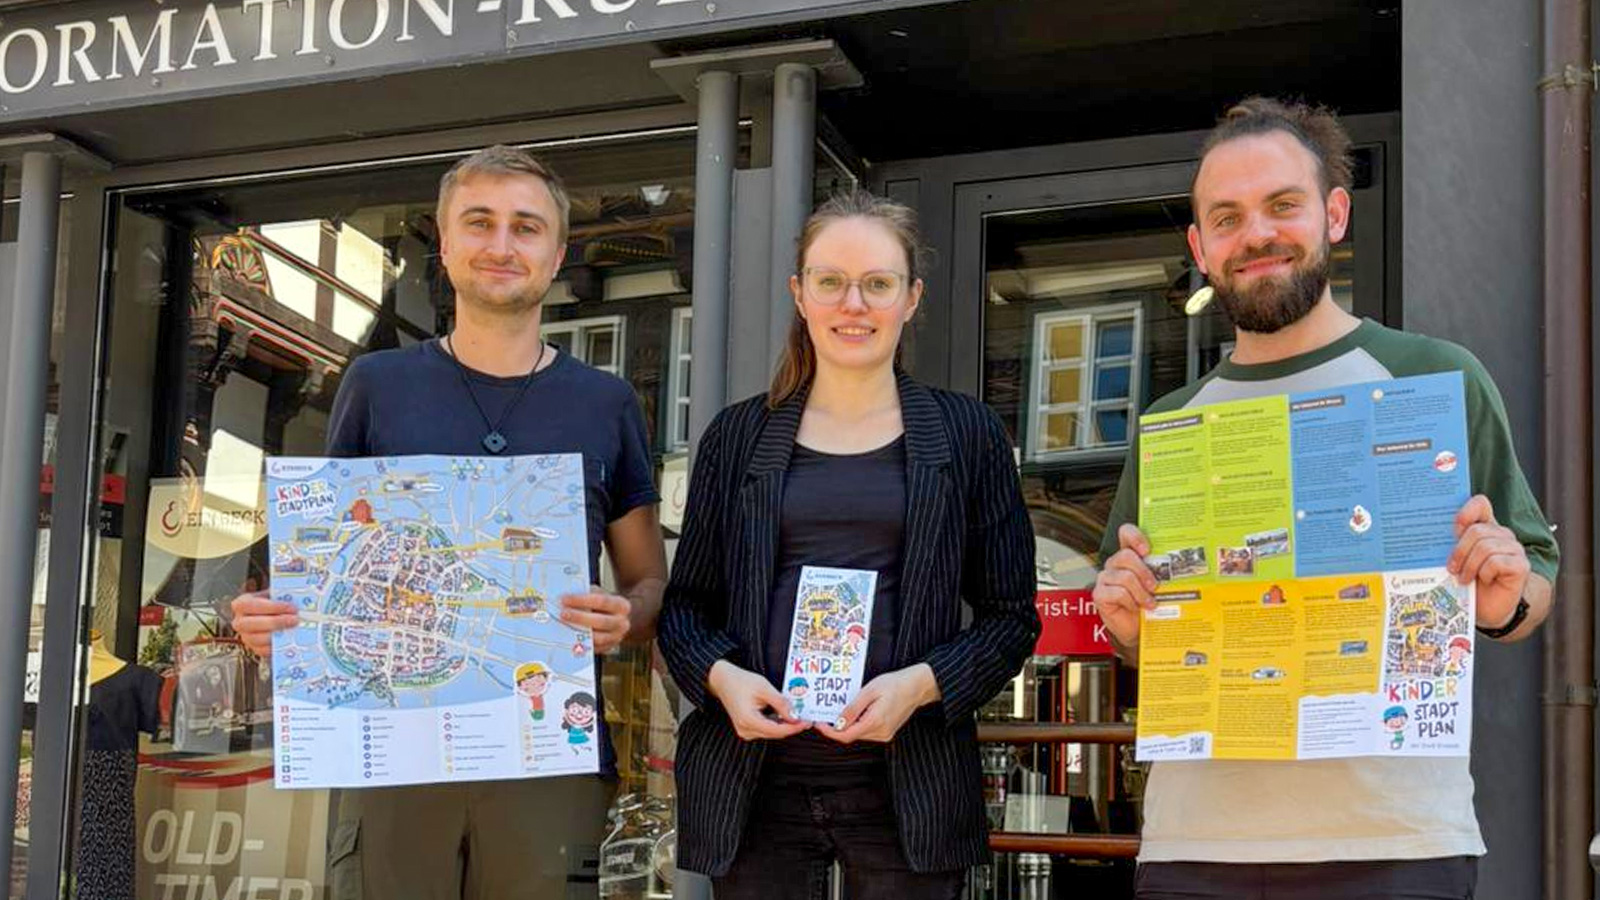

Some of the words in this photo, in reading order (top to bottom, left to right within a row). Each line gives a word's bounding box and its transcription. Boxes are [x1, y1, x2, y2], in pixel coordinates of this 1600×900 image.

[814, 677, 851, 692] STADT
[816, 693, 847, 707] PLAN
[1414, 702, 1459, 721] STADT
[1418, 720, 1455, 738] PLAN
[143, 809, 264, 865] OLD-
